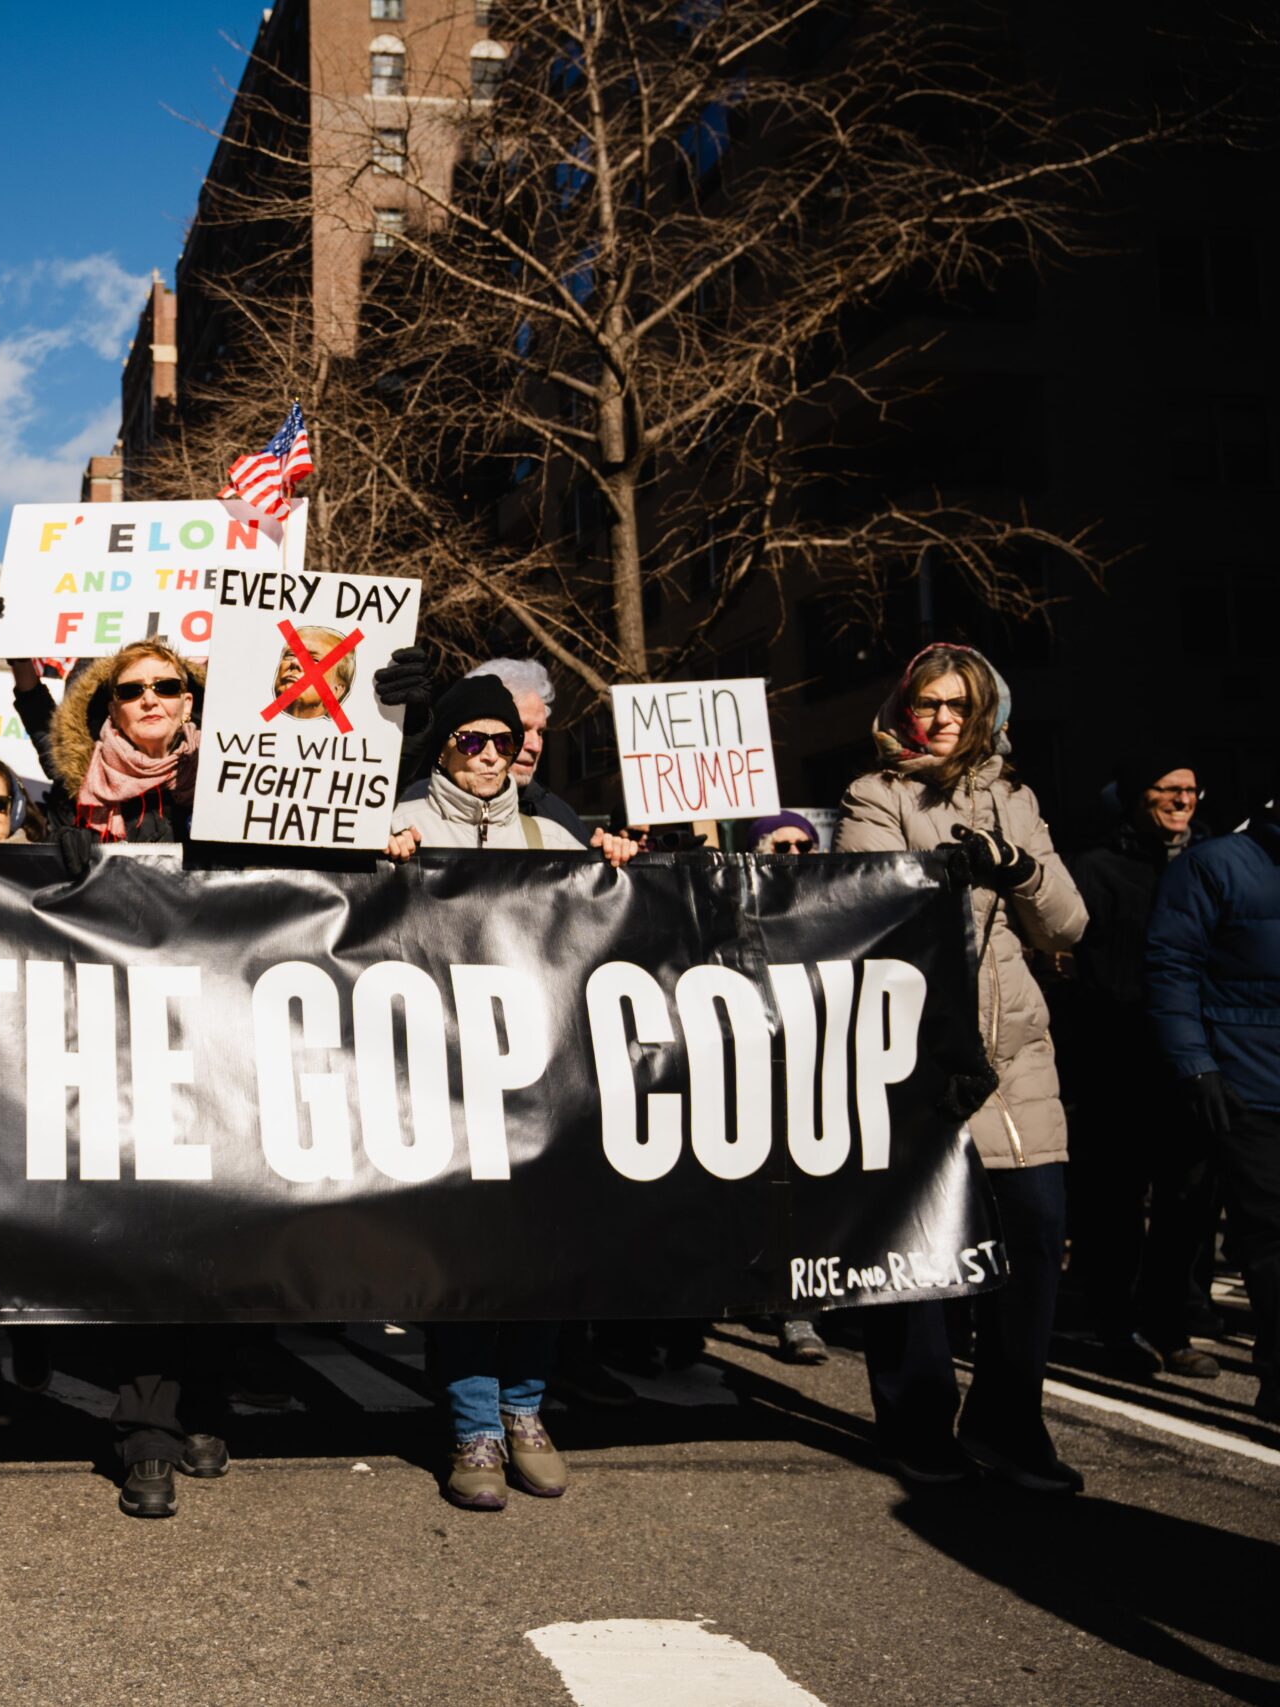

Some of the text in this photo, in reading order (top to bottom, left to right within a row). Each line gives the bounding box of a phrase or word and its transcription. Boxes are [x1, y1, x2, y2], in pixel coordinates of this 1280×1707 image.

[54, 569, 217, 594] AND THE
[220, 569, 411, 624] EVERY DAY
[55, 610, 213, 644] FELO
[216, 732, 382, 763] WE WILL
[217, 761, 389, 808] FIGHT HIS
[623, 749, 764, 814] TRUMPF
[243, 800, 358, 843] HATE
[251, 960, 551, 1183] GOP
[586, 958, 927, 1182] COUP
[791, 1240, 999, 1300] RISE AND RESIST
